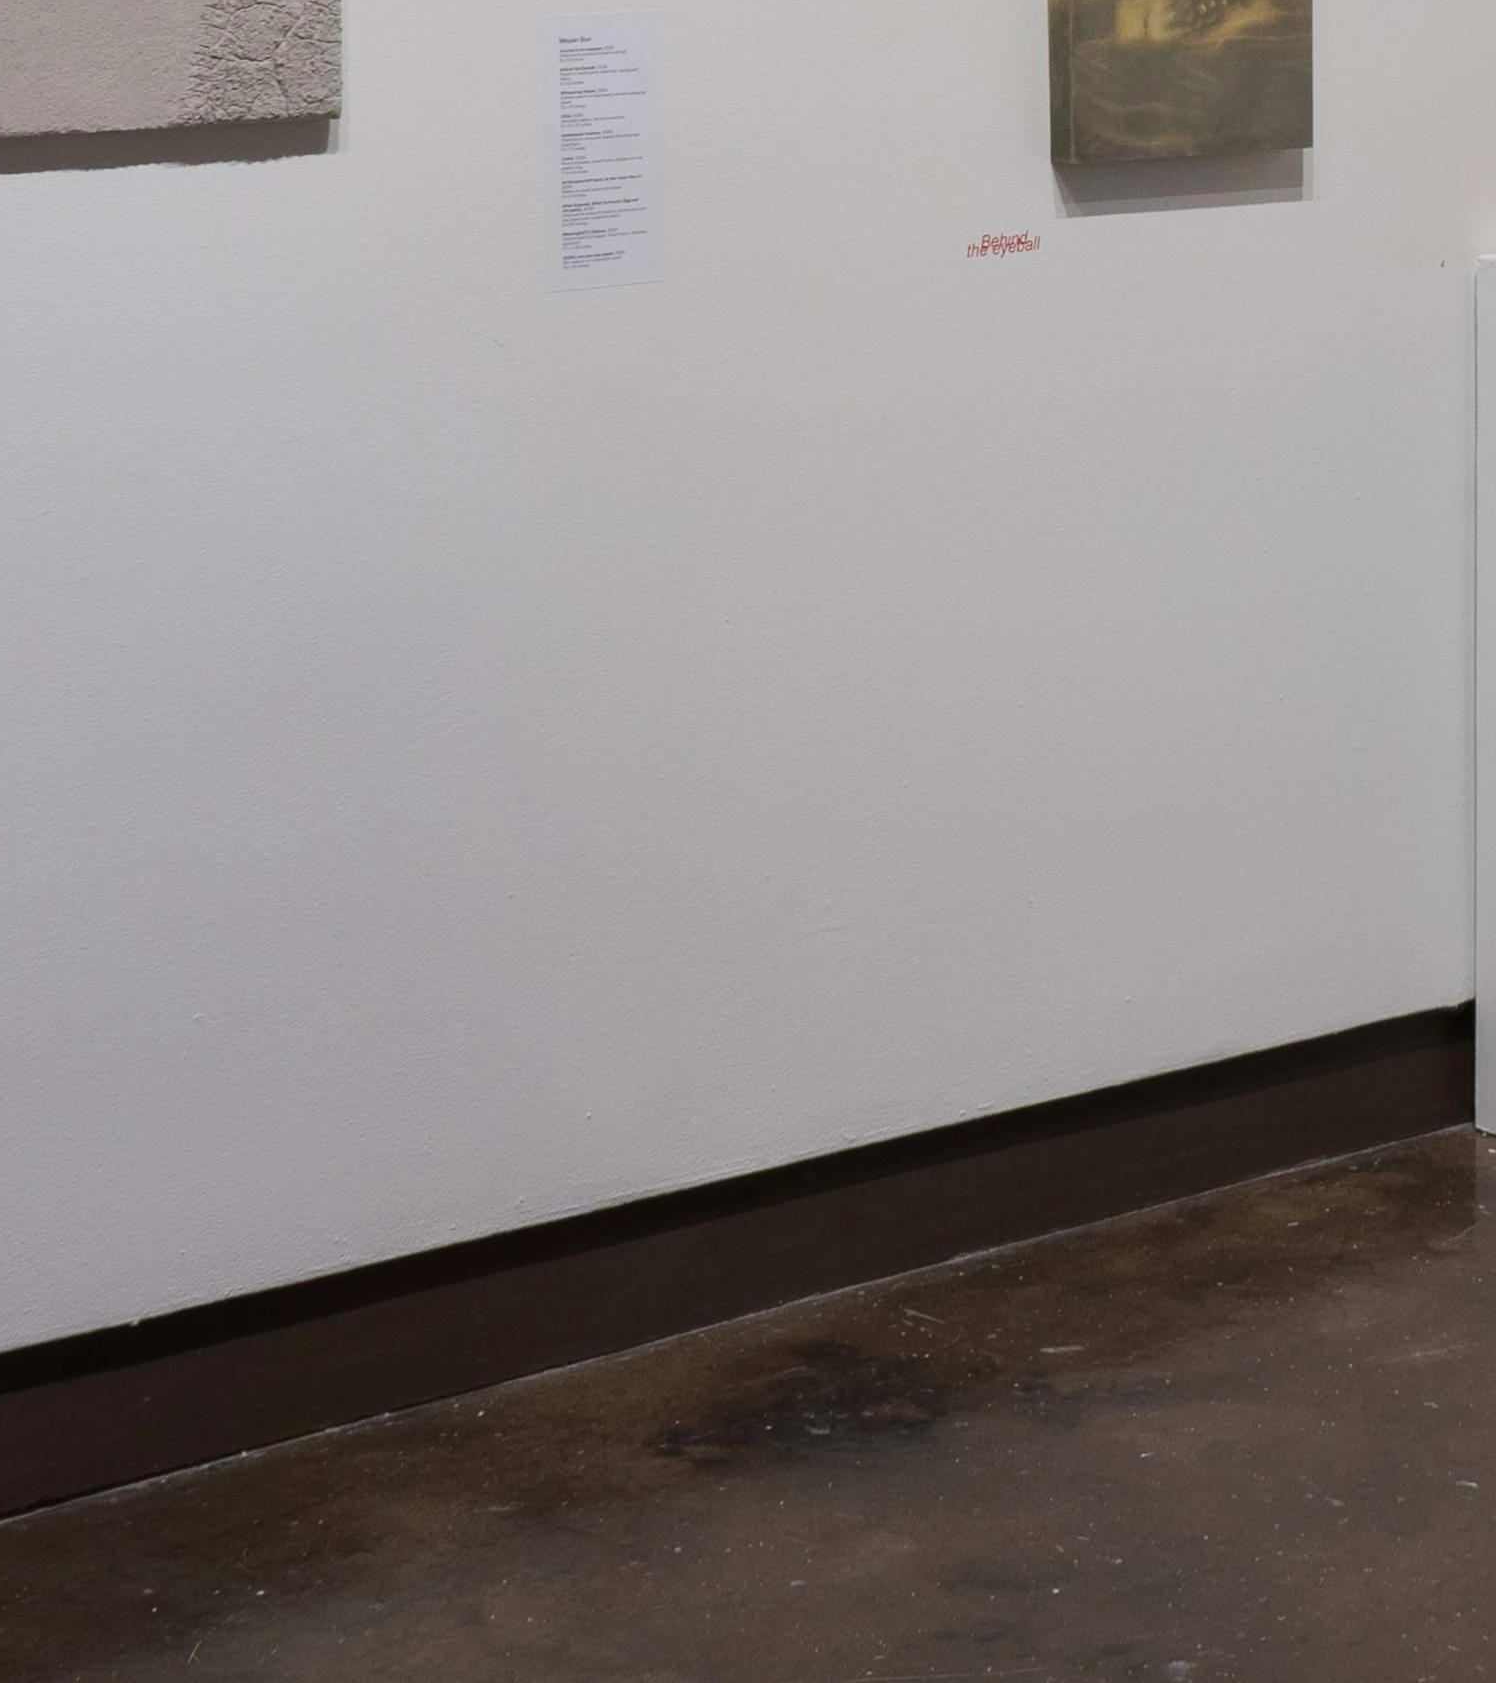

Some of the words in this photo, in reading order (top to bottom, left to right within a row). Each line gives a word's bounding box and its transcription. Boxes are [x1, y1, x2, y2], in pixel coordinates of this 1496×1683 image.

[967, 244, 988, 258] the
[992, 236, 1041, 258] eyeball
[981, 230, 1029, 249] Behind
